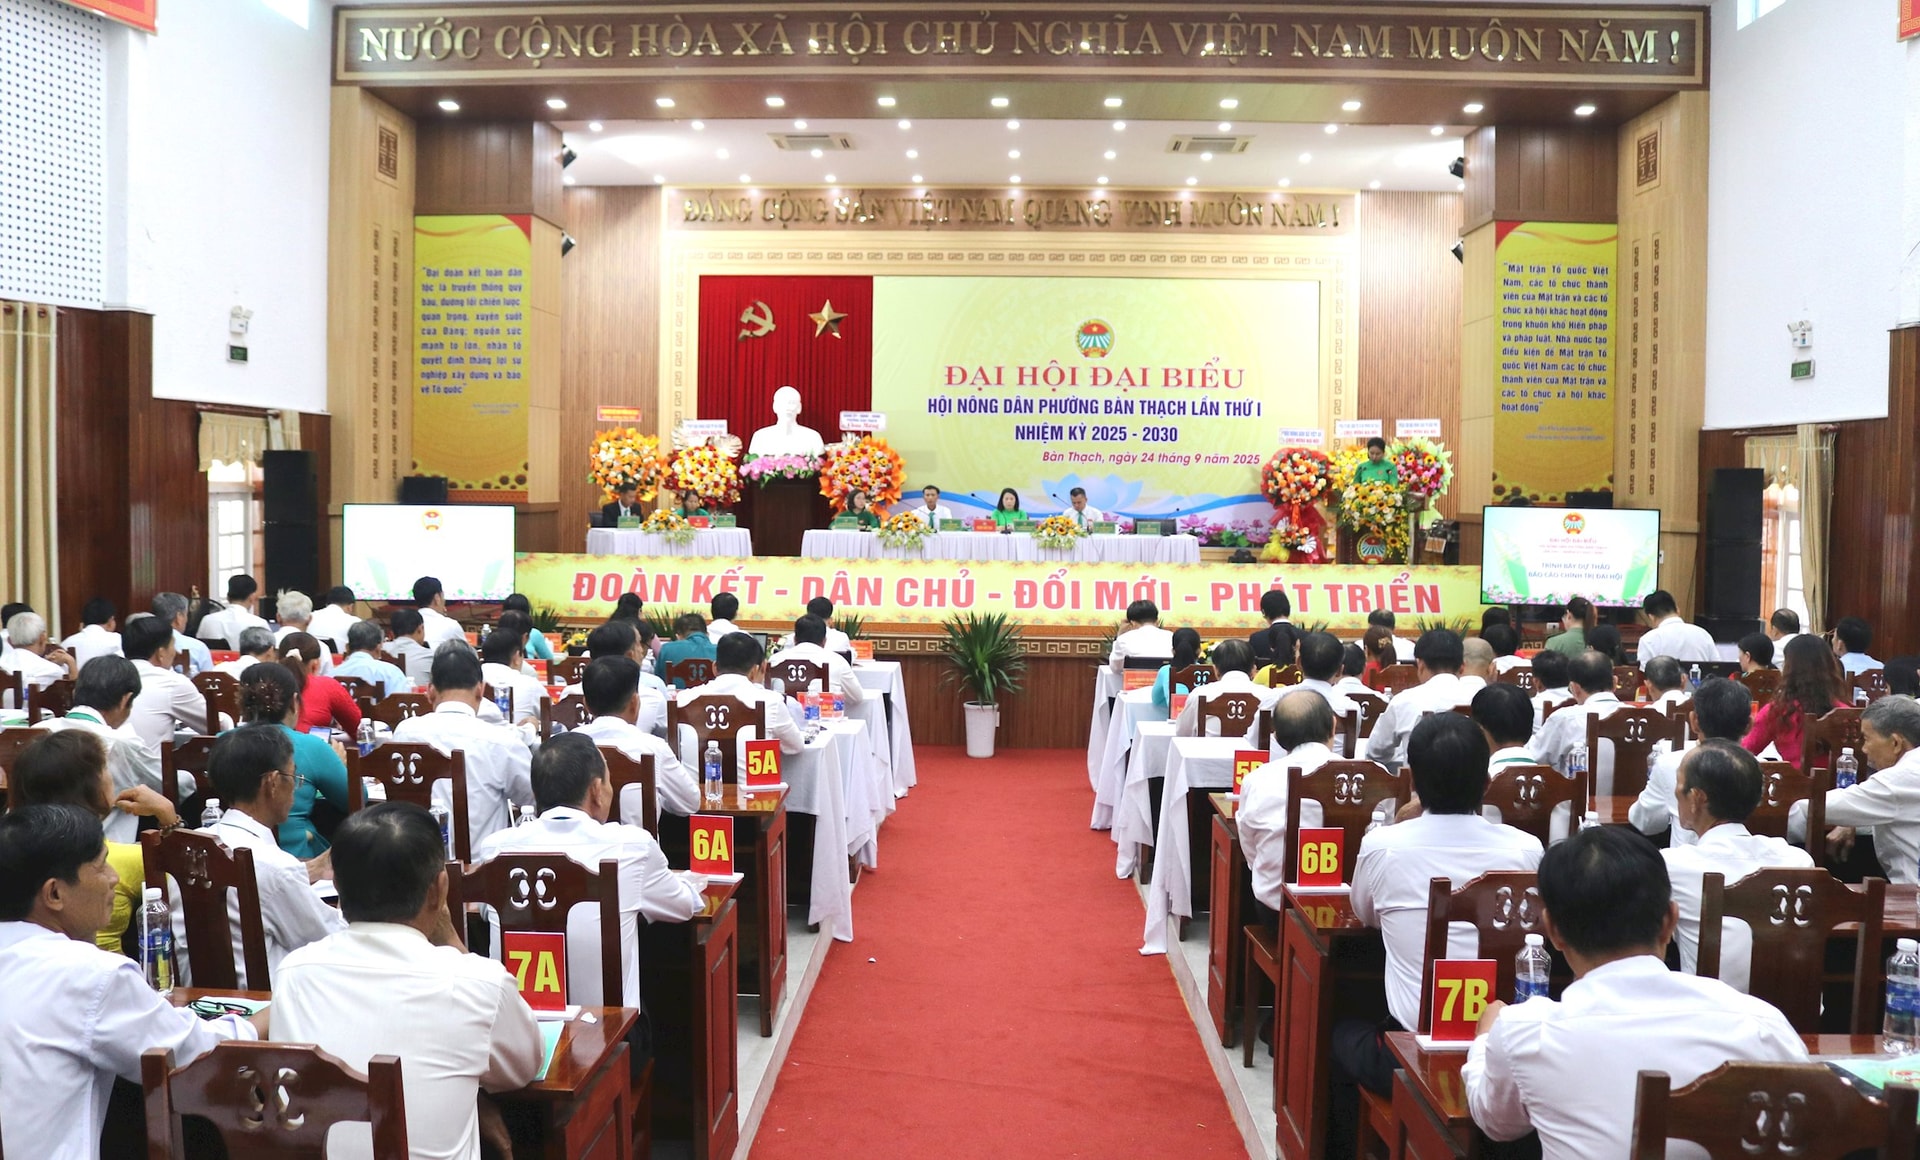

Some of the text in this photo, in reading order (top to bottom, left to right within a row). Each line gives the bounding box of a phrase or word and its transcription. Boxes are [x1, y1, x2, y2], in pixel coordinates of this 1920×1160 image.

[359, 16, 482, 62] NƯỚC
[494, 15, 616, 68] CỘNG
[629, 14, 722, 58] HÒA
[733, 14, 795, 58] XÃ
[807, 15, 886, 65] HỘI
[904, 10, 998, 57] CHỦ
[1012, 14, 1162, 57] NGHĨA
[1175, 13, 1278, 66] VIỆT
[1291, 24, 1393, 59] NAM
[1409, 19, 1544, 61] MUÔN
[1558, 21, 1660, 63] NĂM
[683, 188, 752, 224] ĐẢNG
[761, 190, 828, 229] CỘNG
[834, 189, 884, 223] SẢN
[891, 193, 955, 231] VIỆT
[960, 197, 1015, 224] NAM
[1023, 199, 1112, 231] QUANG
[1120, 201, 1182, 226] VINH
[1190, 193, 1264, 226] MUÔN
[944, 356, 1245, 392] ĐẠI HỘI ĐẠI BIỂU
[928, 396, 1261, 418] HỘI NÔNG DÂN PHƯỜNG BÀN THẠCH LẦN THỨ I
[1015, 423, 1064, 444] NHIỆM
[1068, 422, 1087, 440] KỲ
[1092, 426, 1127, 441] 2025
[1142, 427, 1178, 442] 2030
[1042, 451, 1260, 466] Bàn Thạch, ngày 24 tháng 9 năm 2025
[572, 567, 680, 603] ĐOÀN
[691, 566, 764, 605] KẾT
[801, 570, 882, 606] DÂN
[896, 569, 975, 608] CHỦ
[1014, 568, 1080, 610] ĐỔI
[1096, 575, 1171, 612] MỚI
[1325, 572, 1441, 613] TRIỂN
[748, 750, 777, 774] 5A
[693, 829, 729, 861] 6A
[1302, 843, 1338, 873] 6B
[509, 951, 560, 992] 7A
[1438, 978, 1489, 1022] 7B
